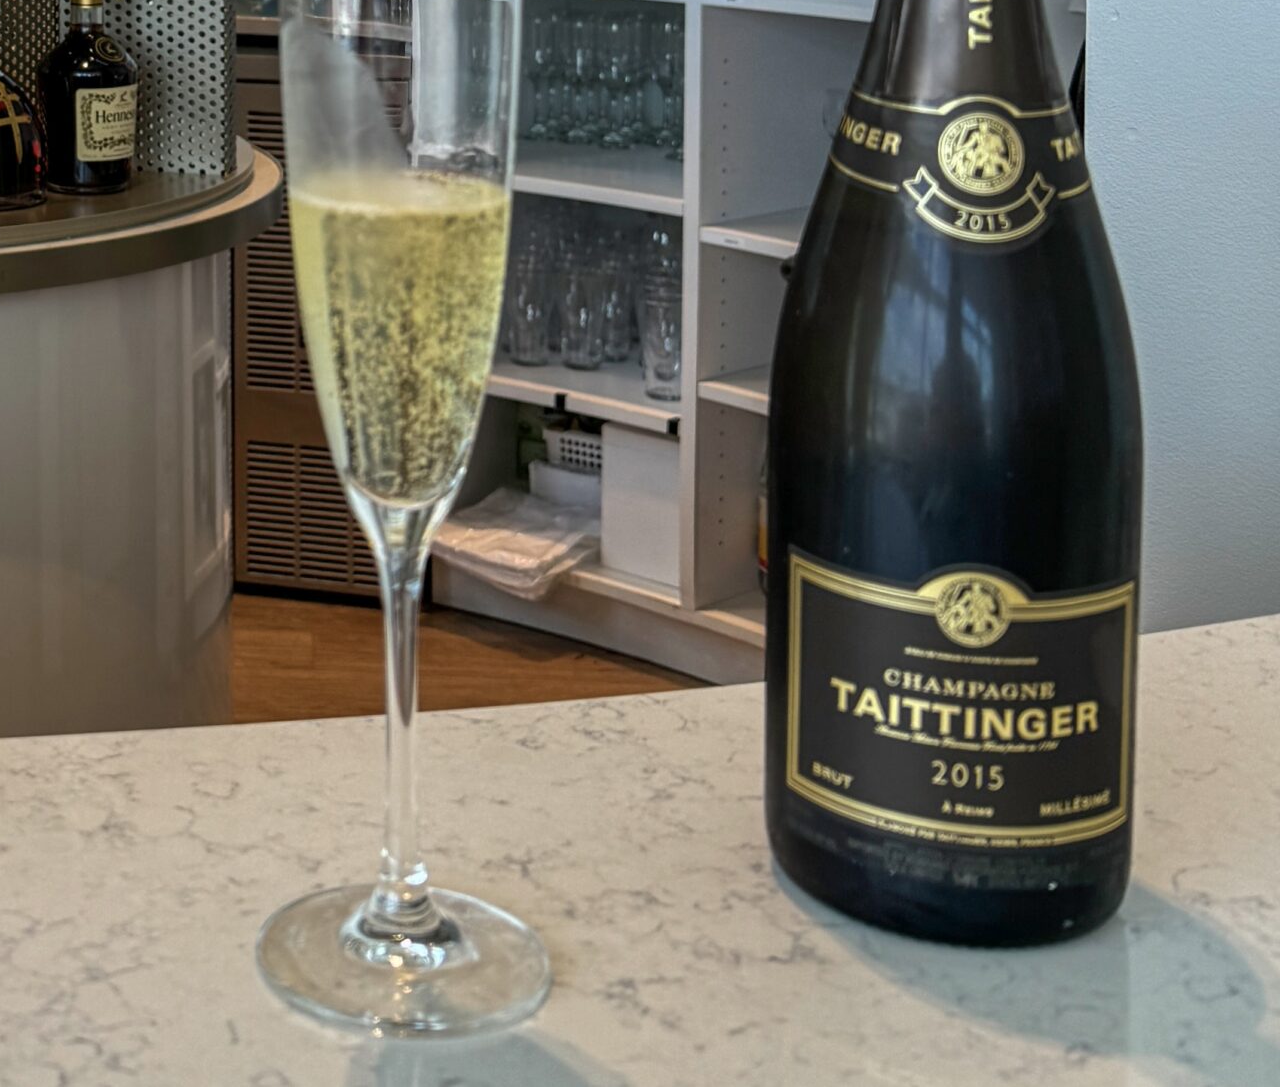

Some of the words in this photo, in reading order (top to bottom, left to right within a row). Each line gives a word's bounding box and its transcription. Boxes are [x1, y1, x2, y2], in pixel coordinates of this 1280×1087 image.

[953, 209, 1013, 232] 2015
[883, 667, 1056, 700] CHAMPAGNE
[830, 676, 1099, 741] TAITTINGER
[811, 761, 854, 789] BRUT
[930, 759, 1006, 792] 2015
